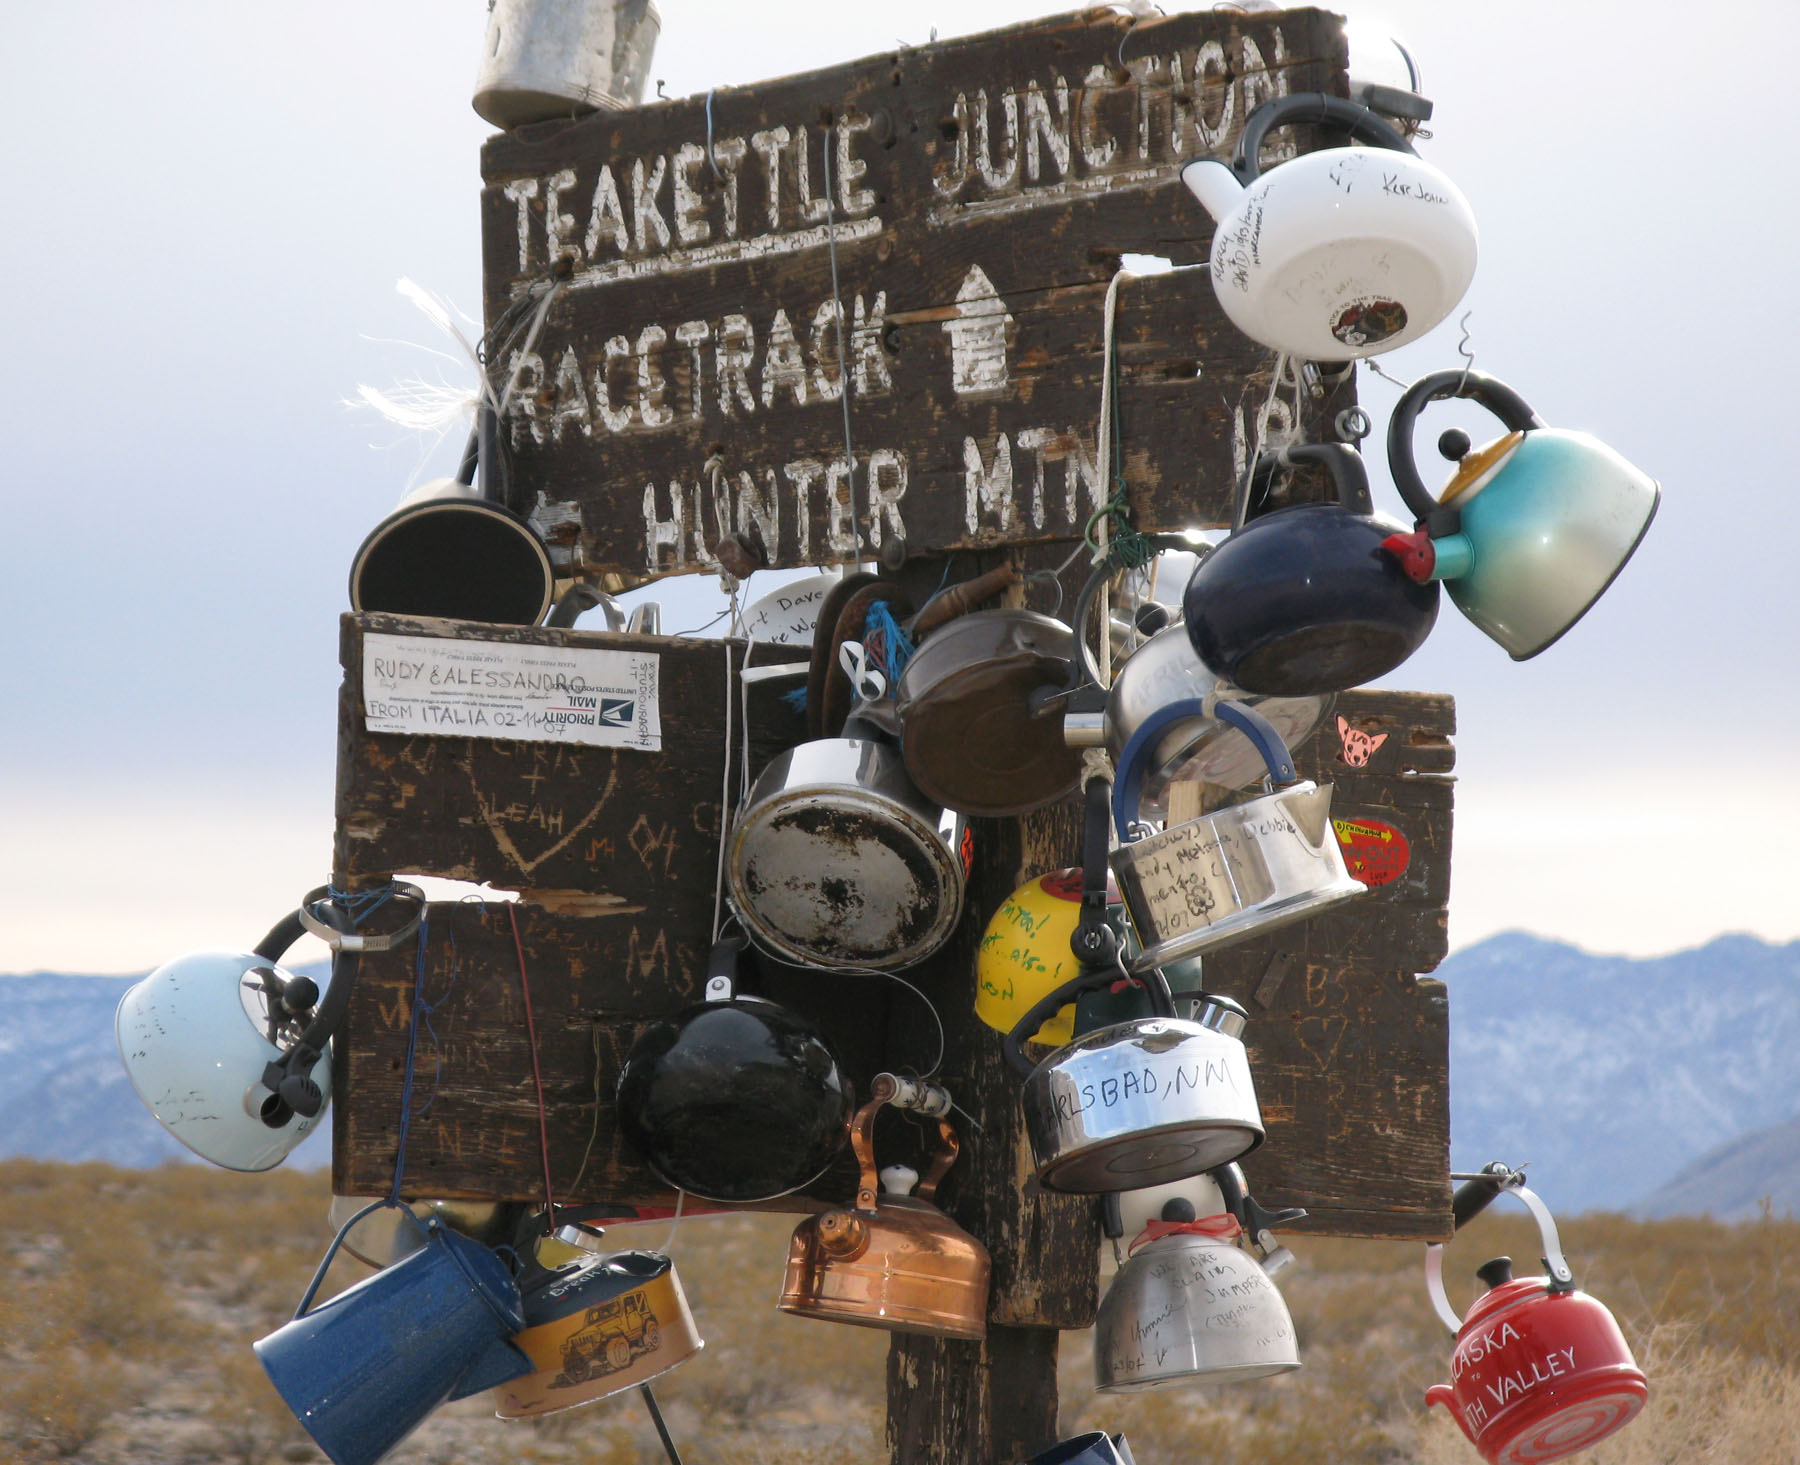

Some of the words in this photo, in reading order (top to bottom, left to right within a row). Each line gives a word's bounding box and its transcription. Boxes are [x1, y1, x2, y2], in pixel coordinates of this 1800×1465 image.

[504, 113, 877, 272] TEAKETTLE
[932, 26, 1289, 196] JUNCTION
[508, 290, 893, 448] RACETRACK
[642, 447, 909, 573] HUNTER
[374, 657, 425, 681] RUDY
[369, 699, 413, 721] FROM
[422, 705, 490, 728] ITALIA
[541, 711, 596, 726] PRIORITY
[566, 695, 597, 708] MAIL
[1486, 1346, 1577, 1406] VALLEY
